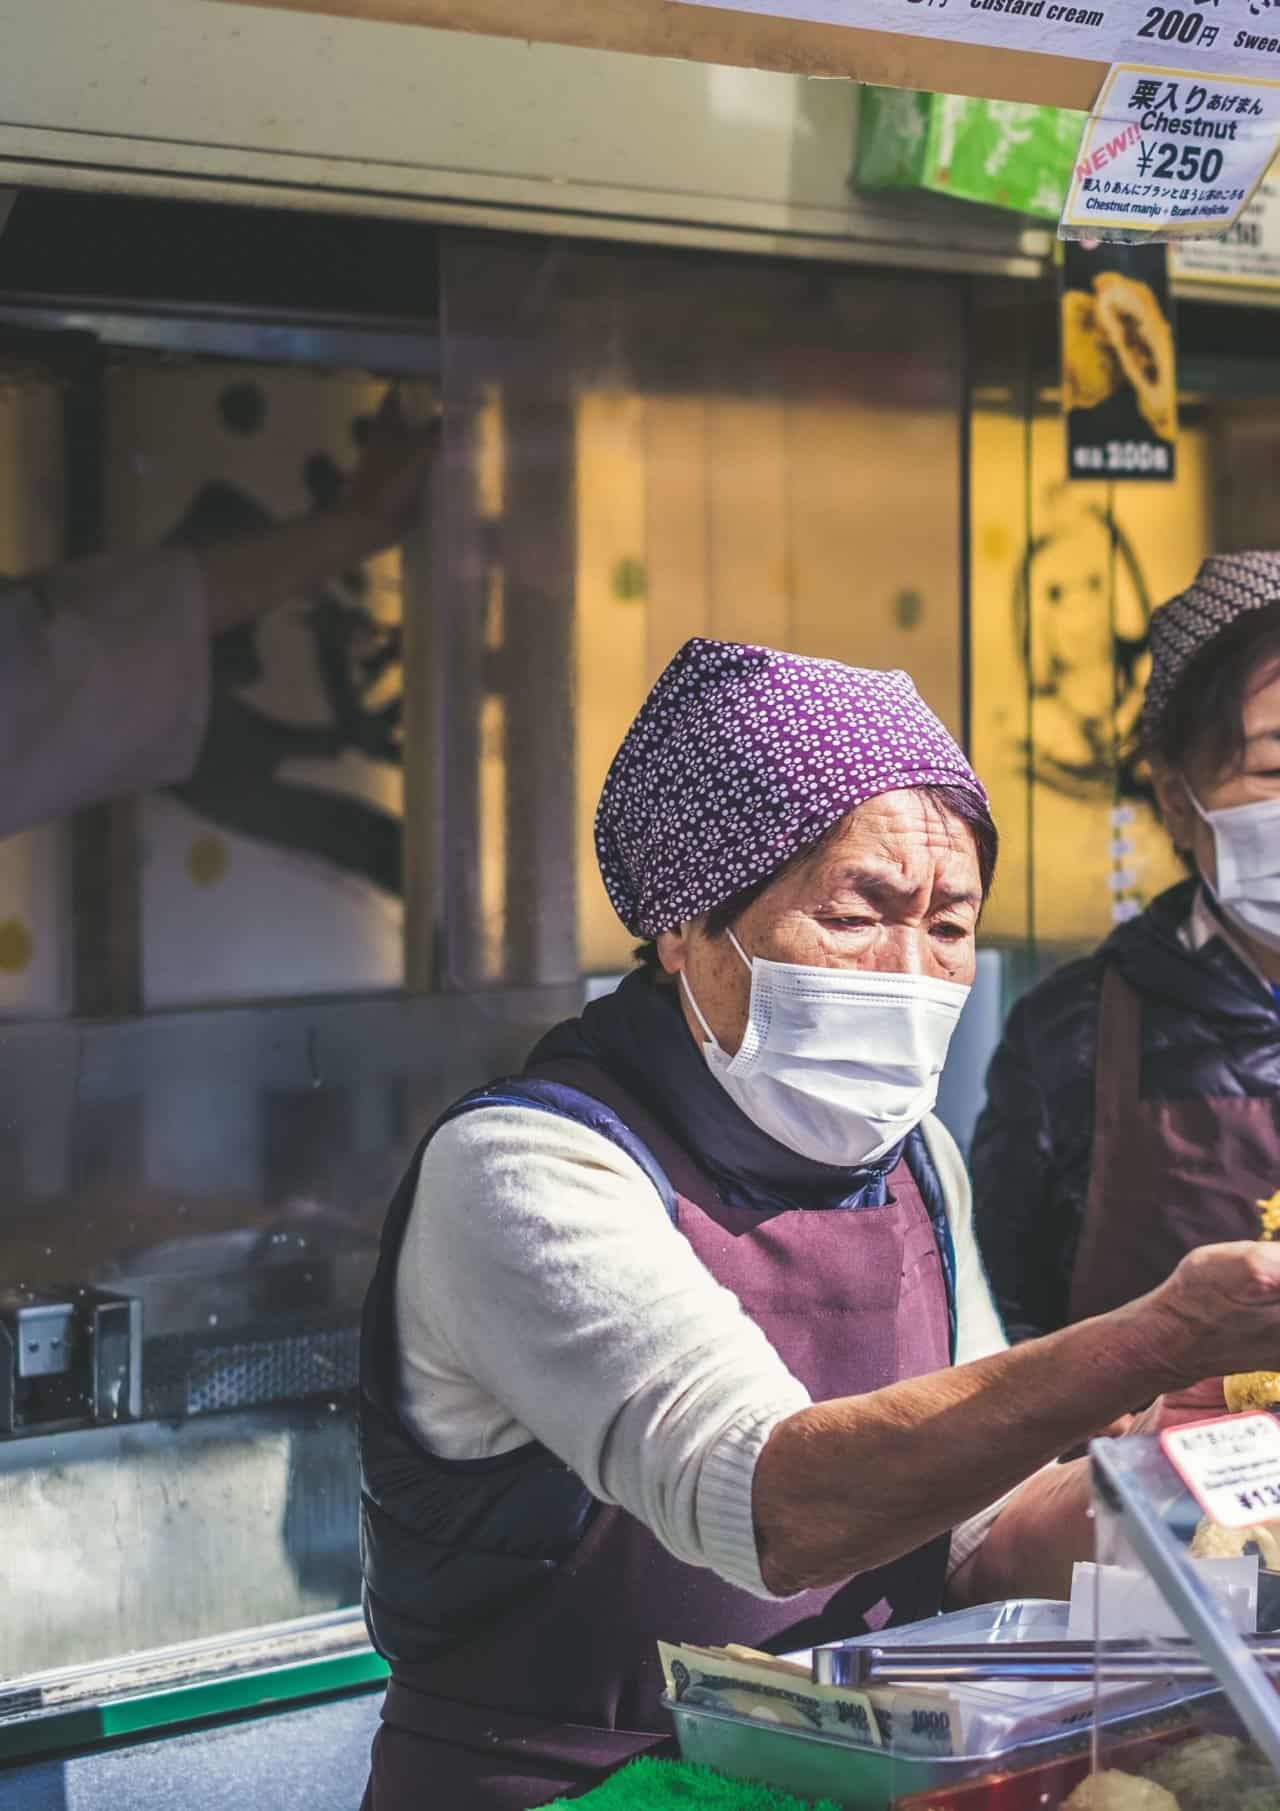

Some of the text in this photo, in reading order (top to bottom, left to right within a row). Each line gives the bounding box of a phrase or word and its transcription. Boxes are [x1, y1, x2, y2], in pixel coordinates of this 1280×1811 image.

[1046, 4, 1104, 26] cream
[1137, 7, 1220, 47] 200円
[1140, 111, 1238, 140] Chestnut
[1075, 121, 1142, 183] NEW!!
[1136, 140, 1224, 184] ¥250
[1085, 197, 1131, 213] Chestnut
[1130, 203, 1162, 218] manju
